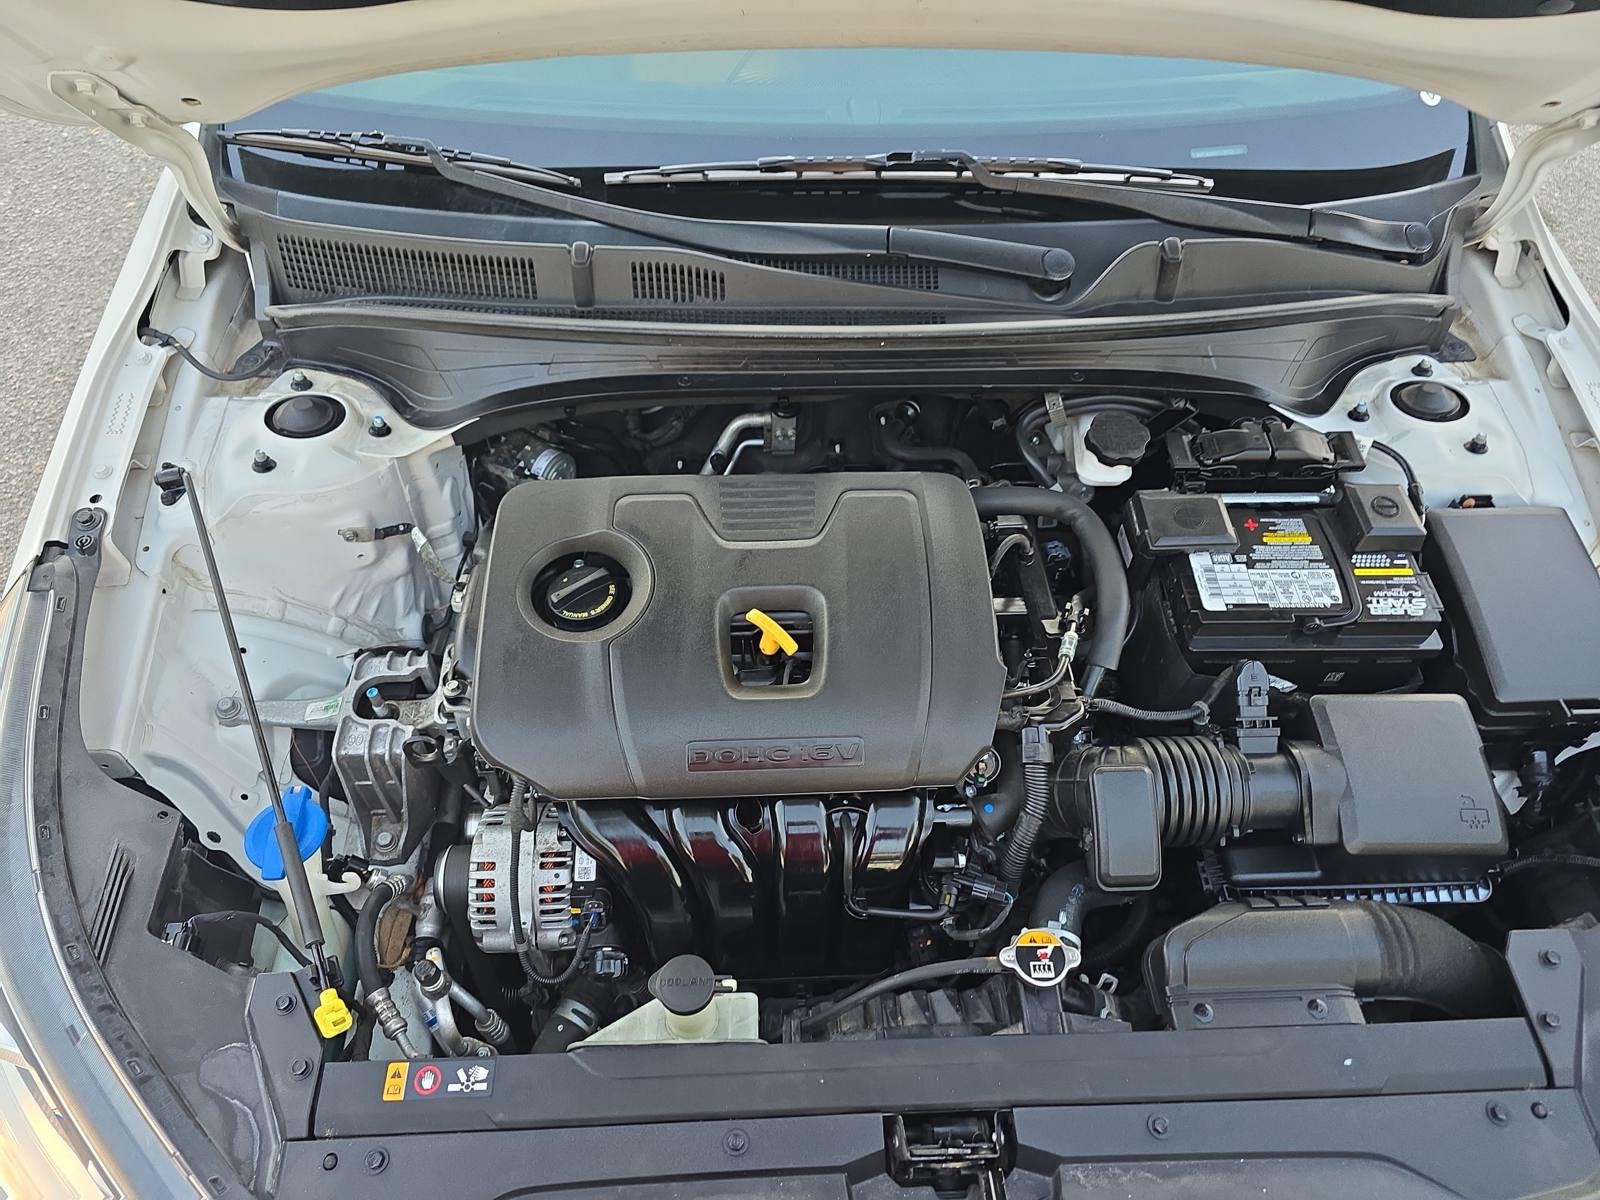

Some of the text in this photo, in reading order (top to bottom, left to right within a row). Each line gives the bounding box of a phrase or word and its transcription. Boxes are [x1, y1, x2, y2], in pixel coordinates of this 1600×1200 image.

[562, 610, 588, 618] MANUAL
[1370, 606, 1424, 616] SUPER
[689, 743, 861, 765] DOHC 16V
[660, 977, 713, 987] COOLANT
